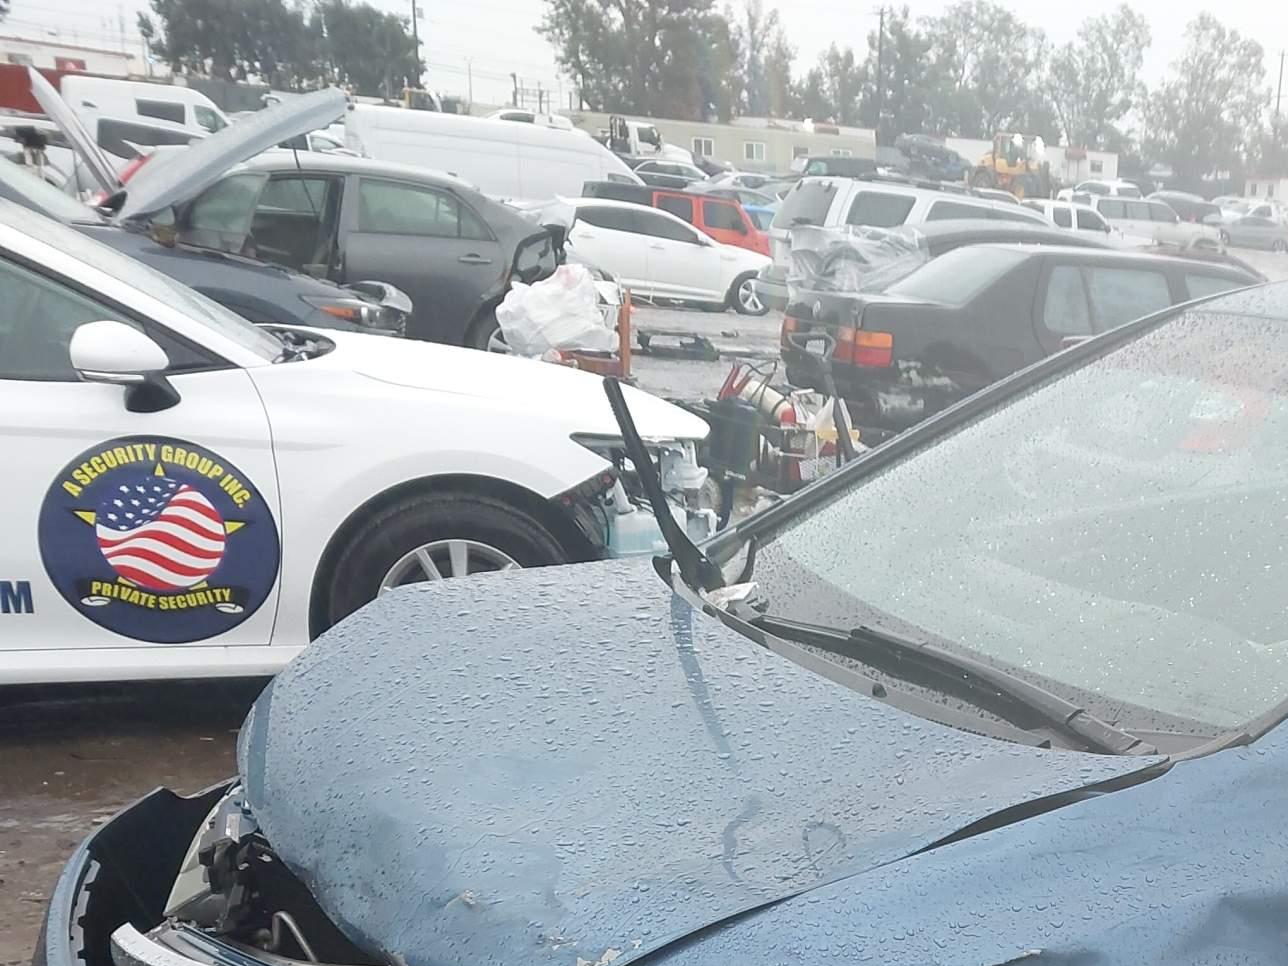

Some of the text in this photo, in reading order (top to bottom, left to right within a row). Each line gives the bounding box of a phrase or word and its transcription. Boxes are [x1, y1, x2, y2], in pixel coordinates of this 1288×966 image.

[62, 443, 252, 508] A SECURITY GROUP INC.
[91, 580, 231, 611] PRIVATE SECURITY
